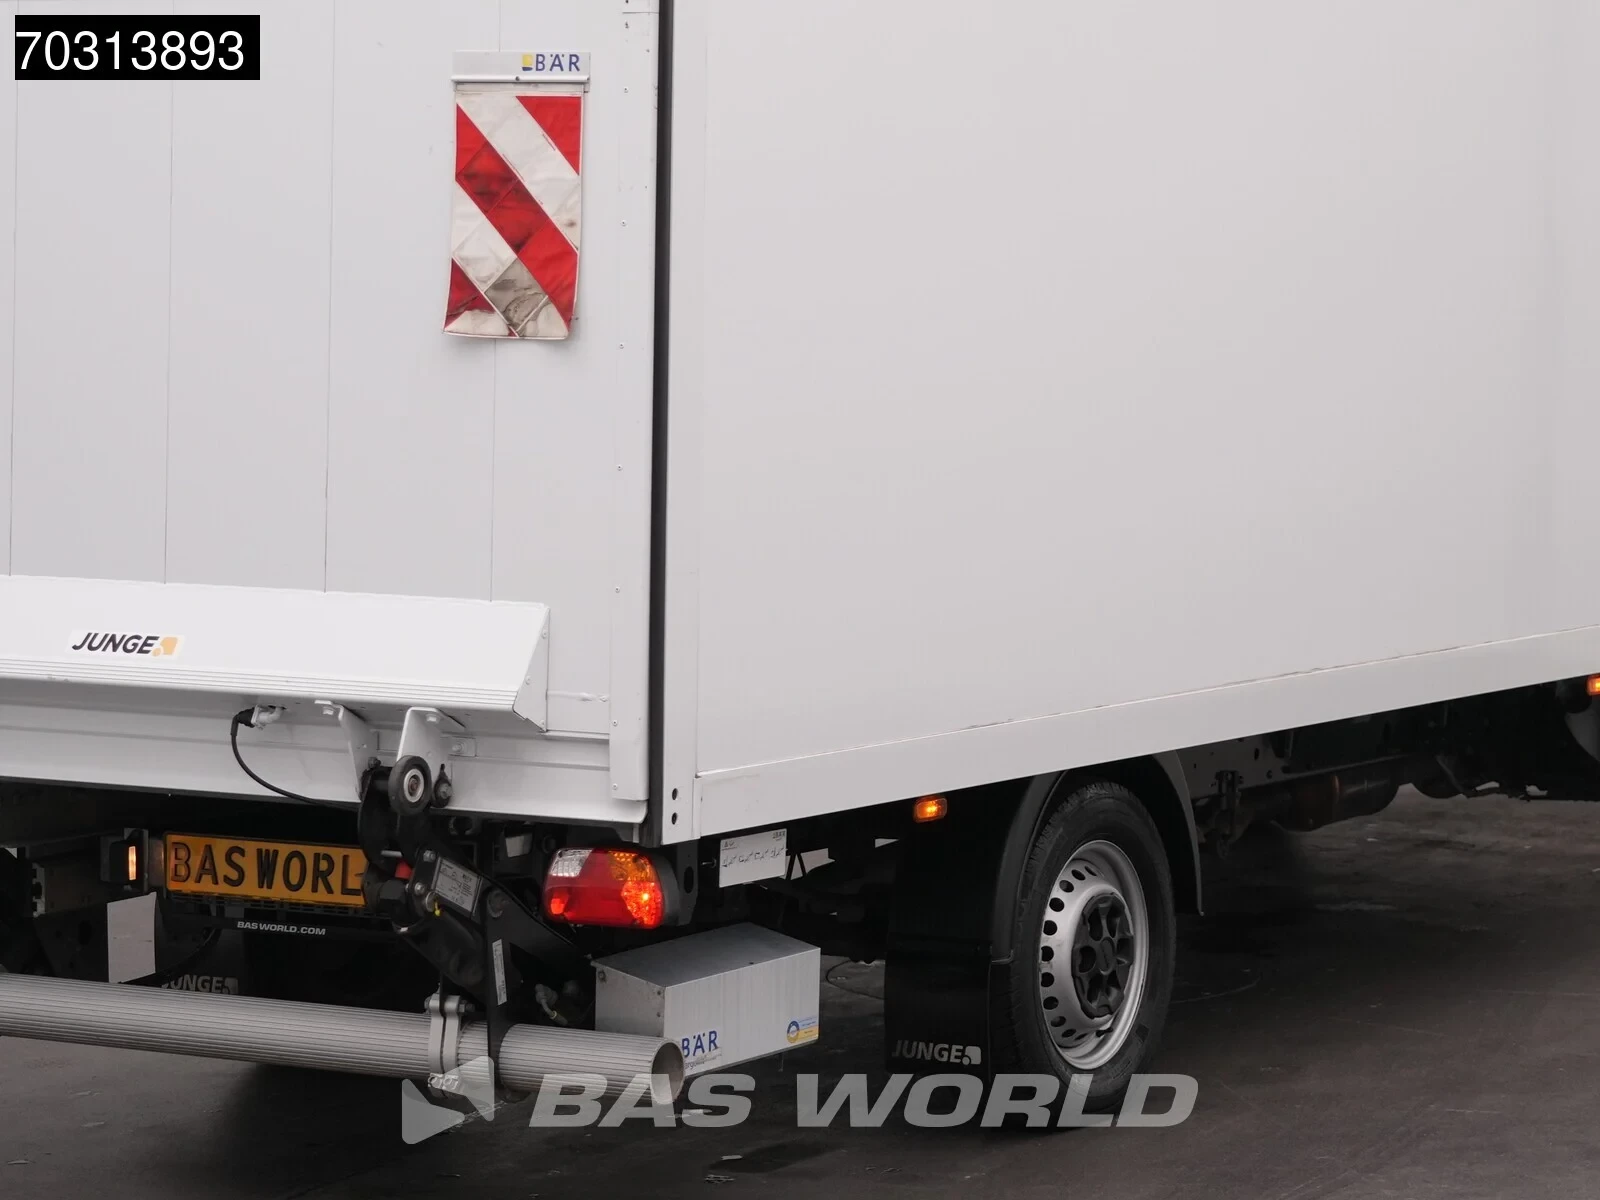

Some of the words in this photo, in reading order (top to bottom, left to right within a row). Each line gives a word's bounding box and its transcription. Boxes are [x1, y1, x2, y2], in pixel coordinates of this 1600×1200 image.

[535, 53, 580, 72] BÄR
[71, 632, 160, 654] JUNGE
[170, 842, 246, 887] BAS
[236, 920, 259, 930] BAS
[259, 923, 326, 936] WORLD.COM
[681, 1030, 720, 1058] BÄR
[891, 1040, 964, 1063] JUNGE
